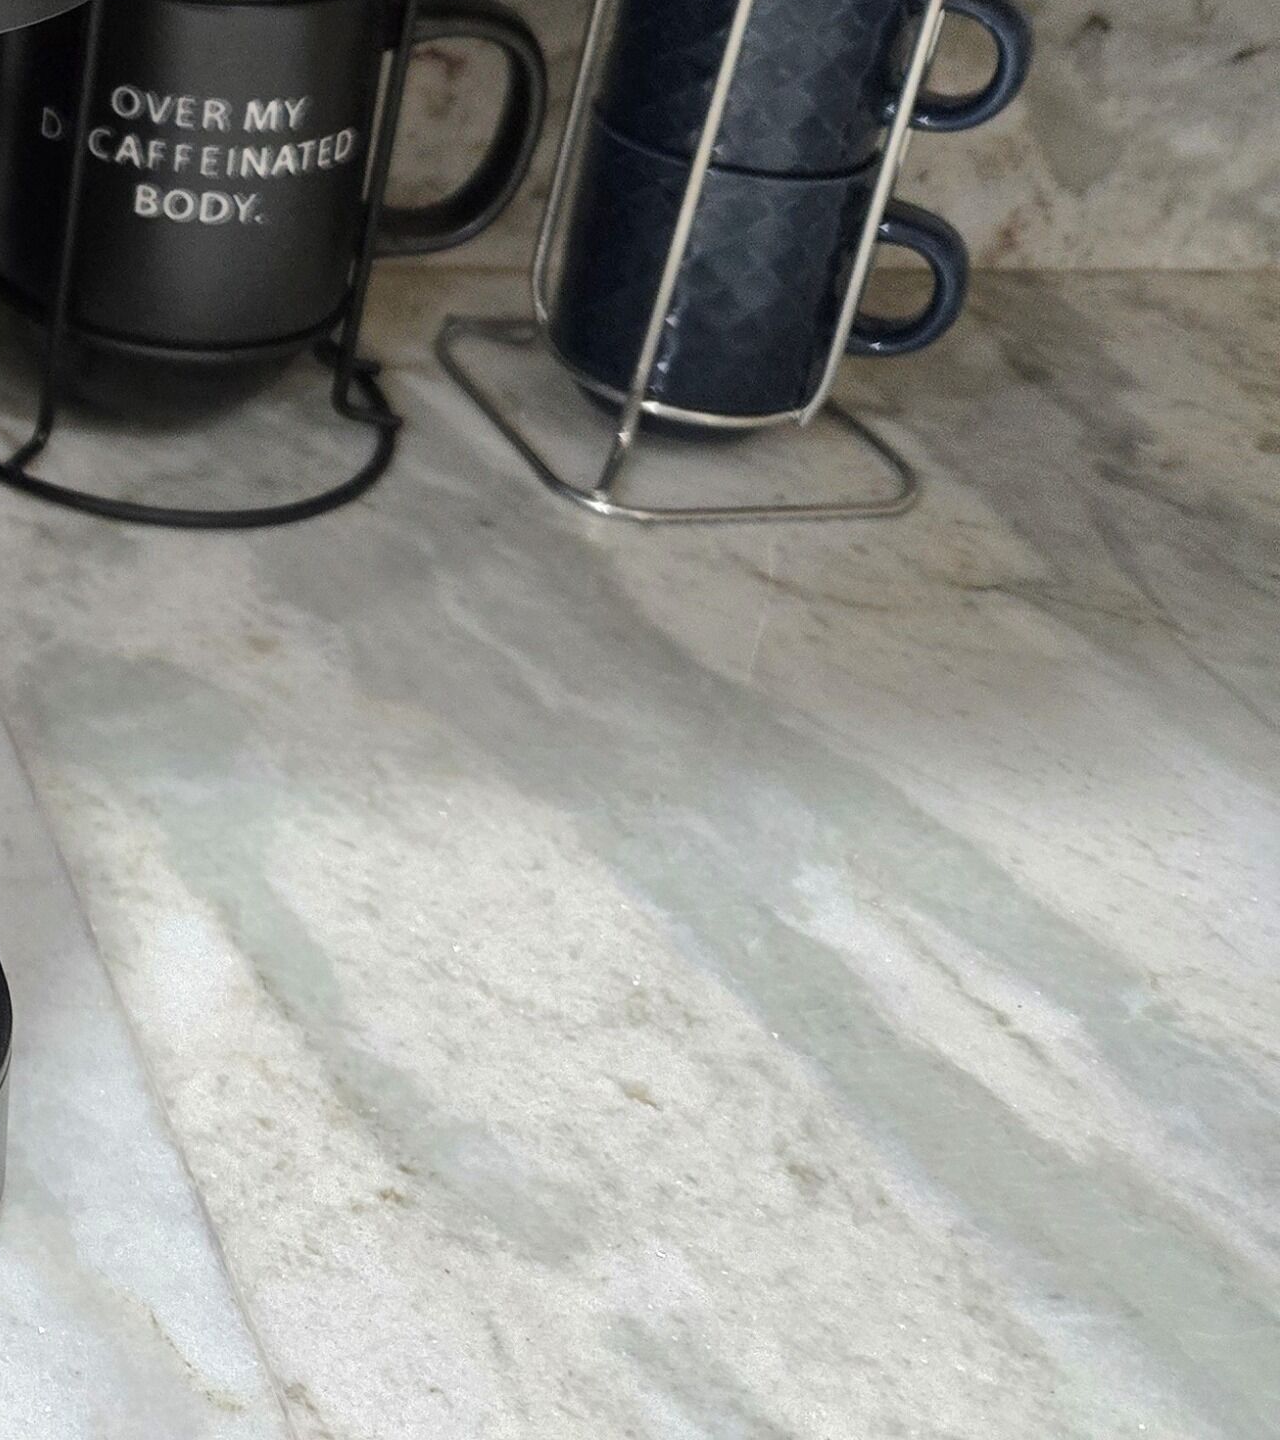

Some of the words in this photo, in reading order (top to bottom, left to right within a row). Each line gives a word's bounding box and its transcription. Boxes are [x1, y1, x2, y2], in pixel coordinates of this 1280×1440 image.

[111, 85, 229, 131] OVER
[242, 95, 308, 131] MY
[134, 184, 265, 226] BODY.
